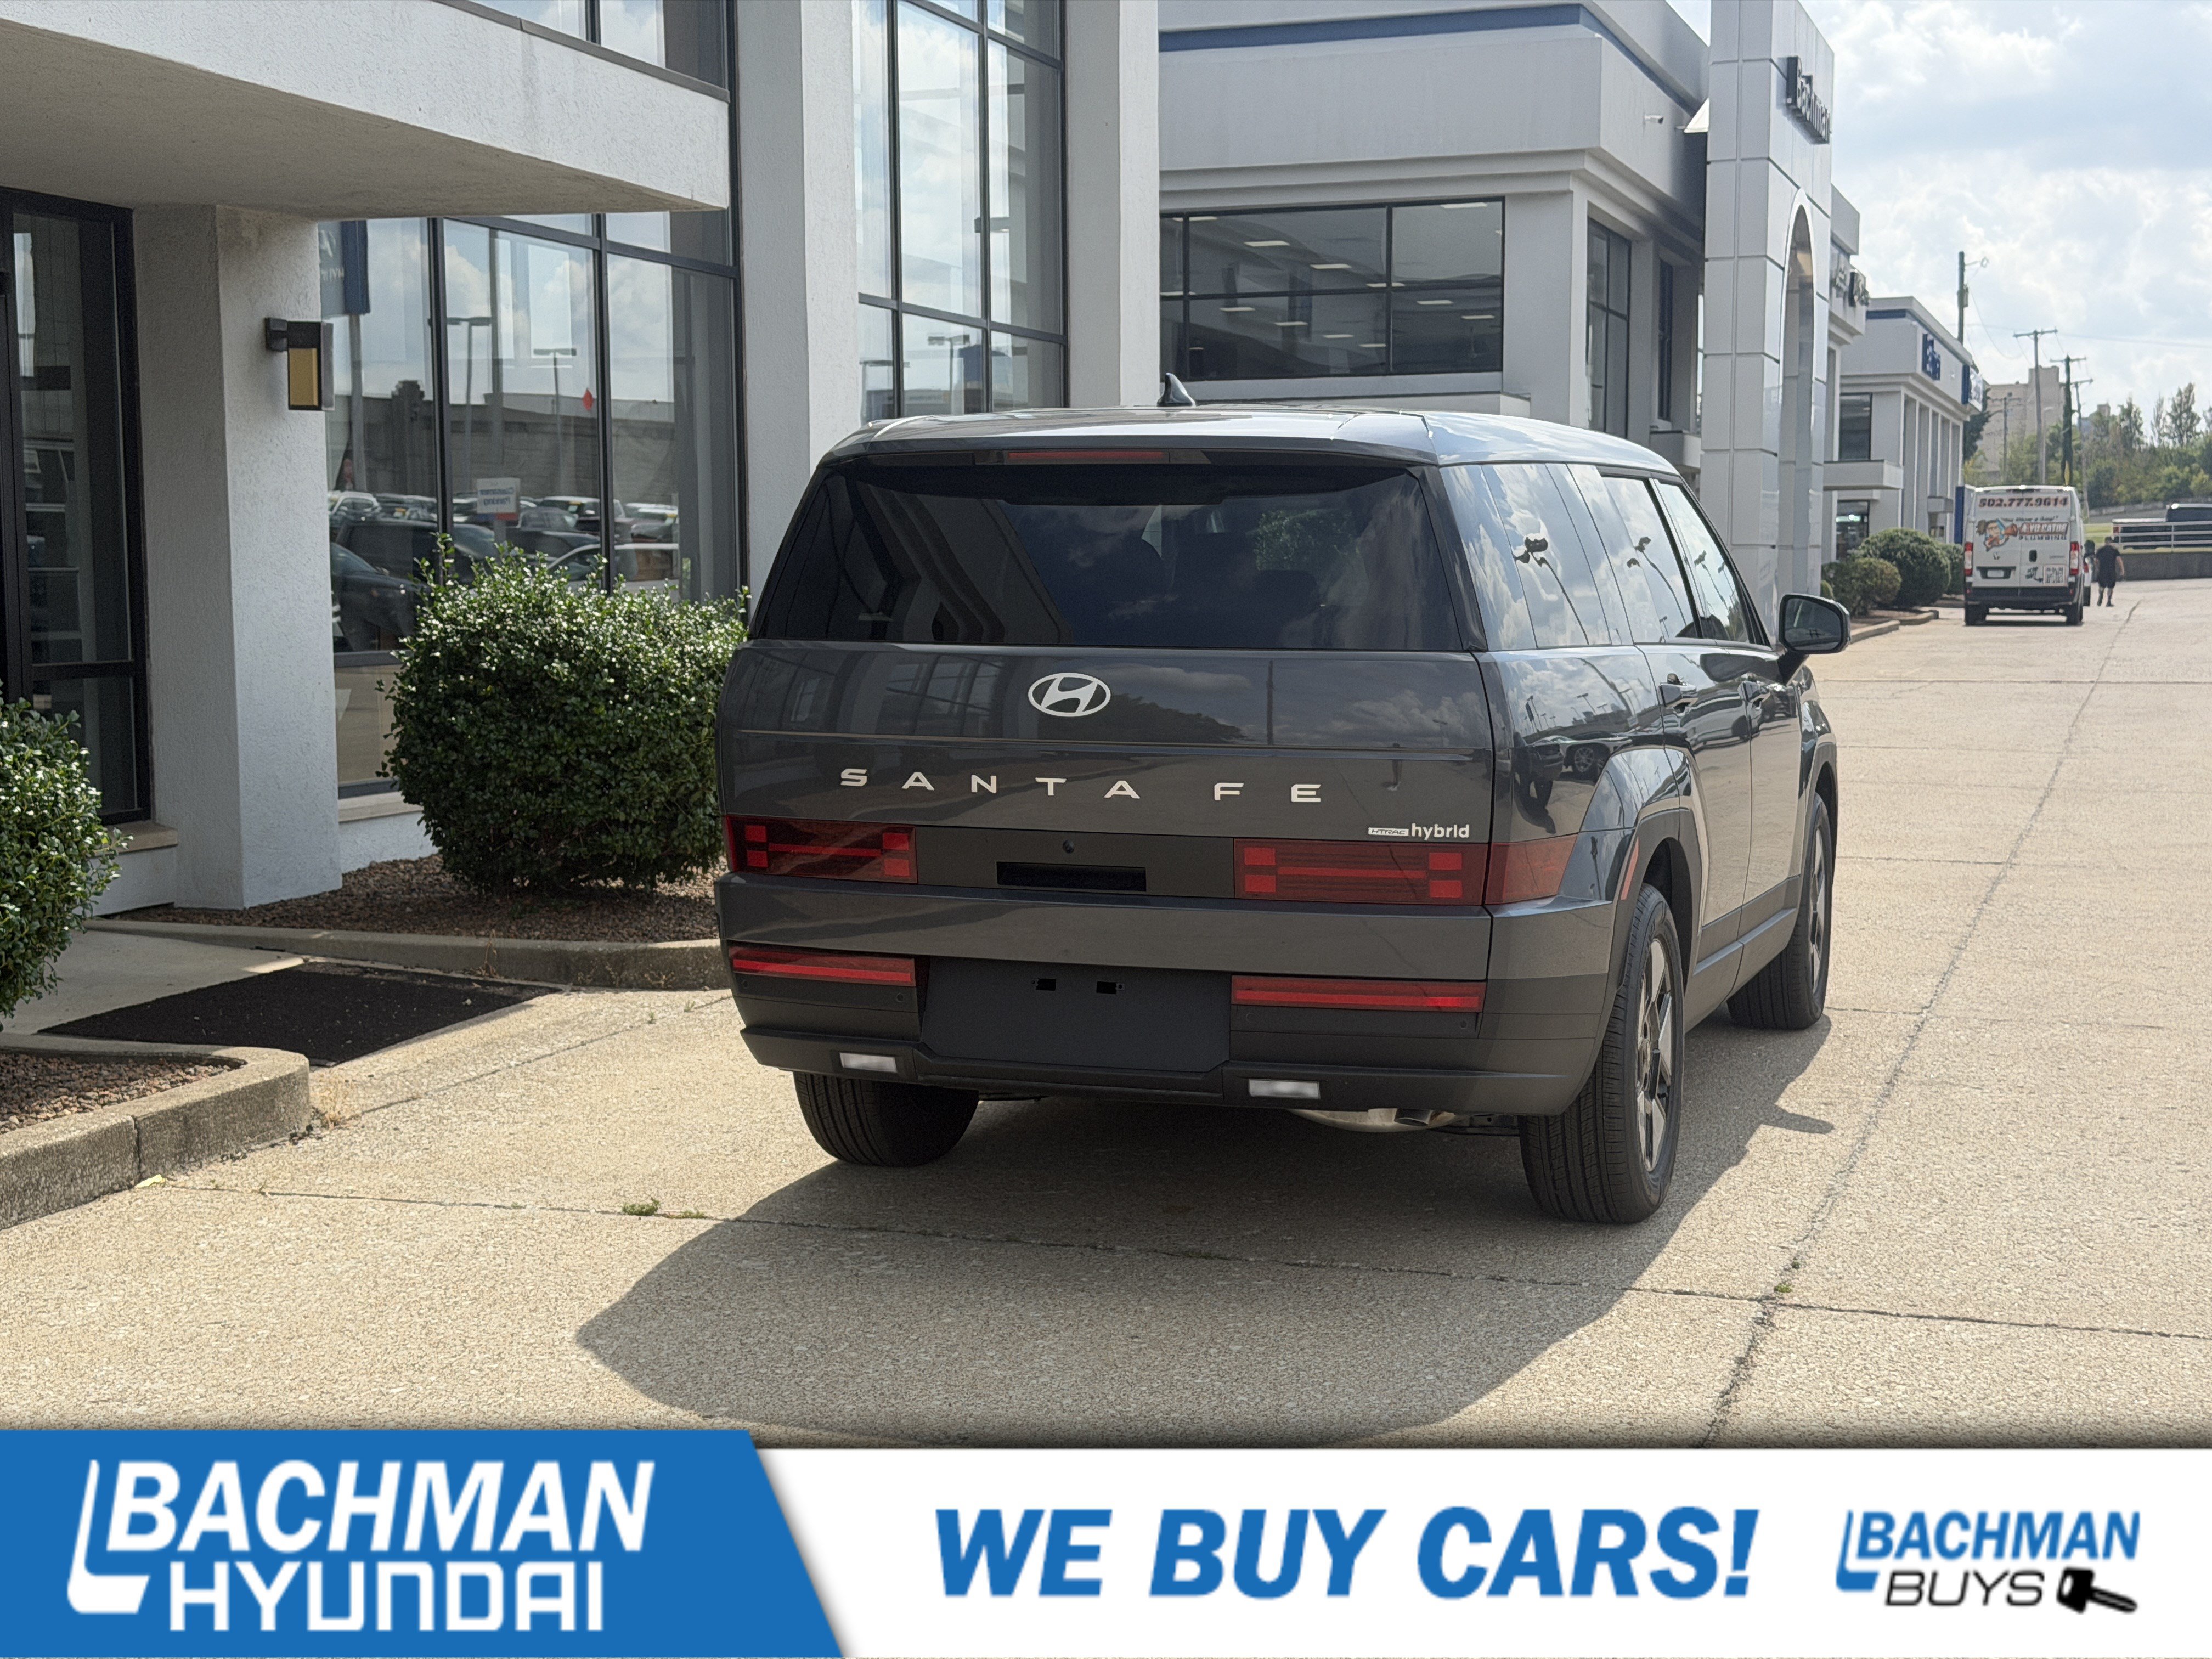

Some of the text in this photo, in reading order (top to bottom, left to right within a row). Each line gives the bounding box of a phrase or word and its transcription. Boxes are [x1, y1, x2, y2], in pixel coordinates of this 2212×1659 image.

[1978, 496, 2069, 507] 502.777.9614
[840, 769, 1321, 803] SANTA FE
[1411, 823, 1470, 840] hybrid
